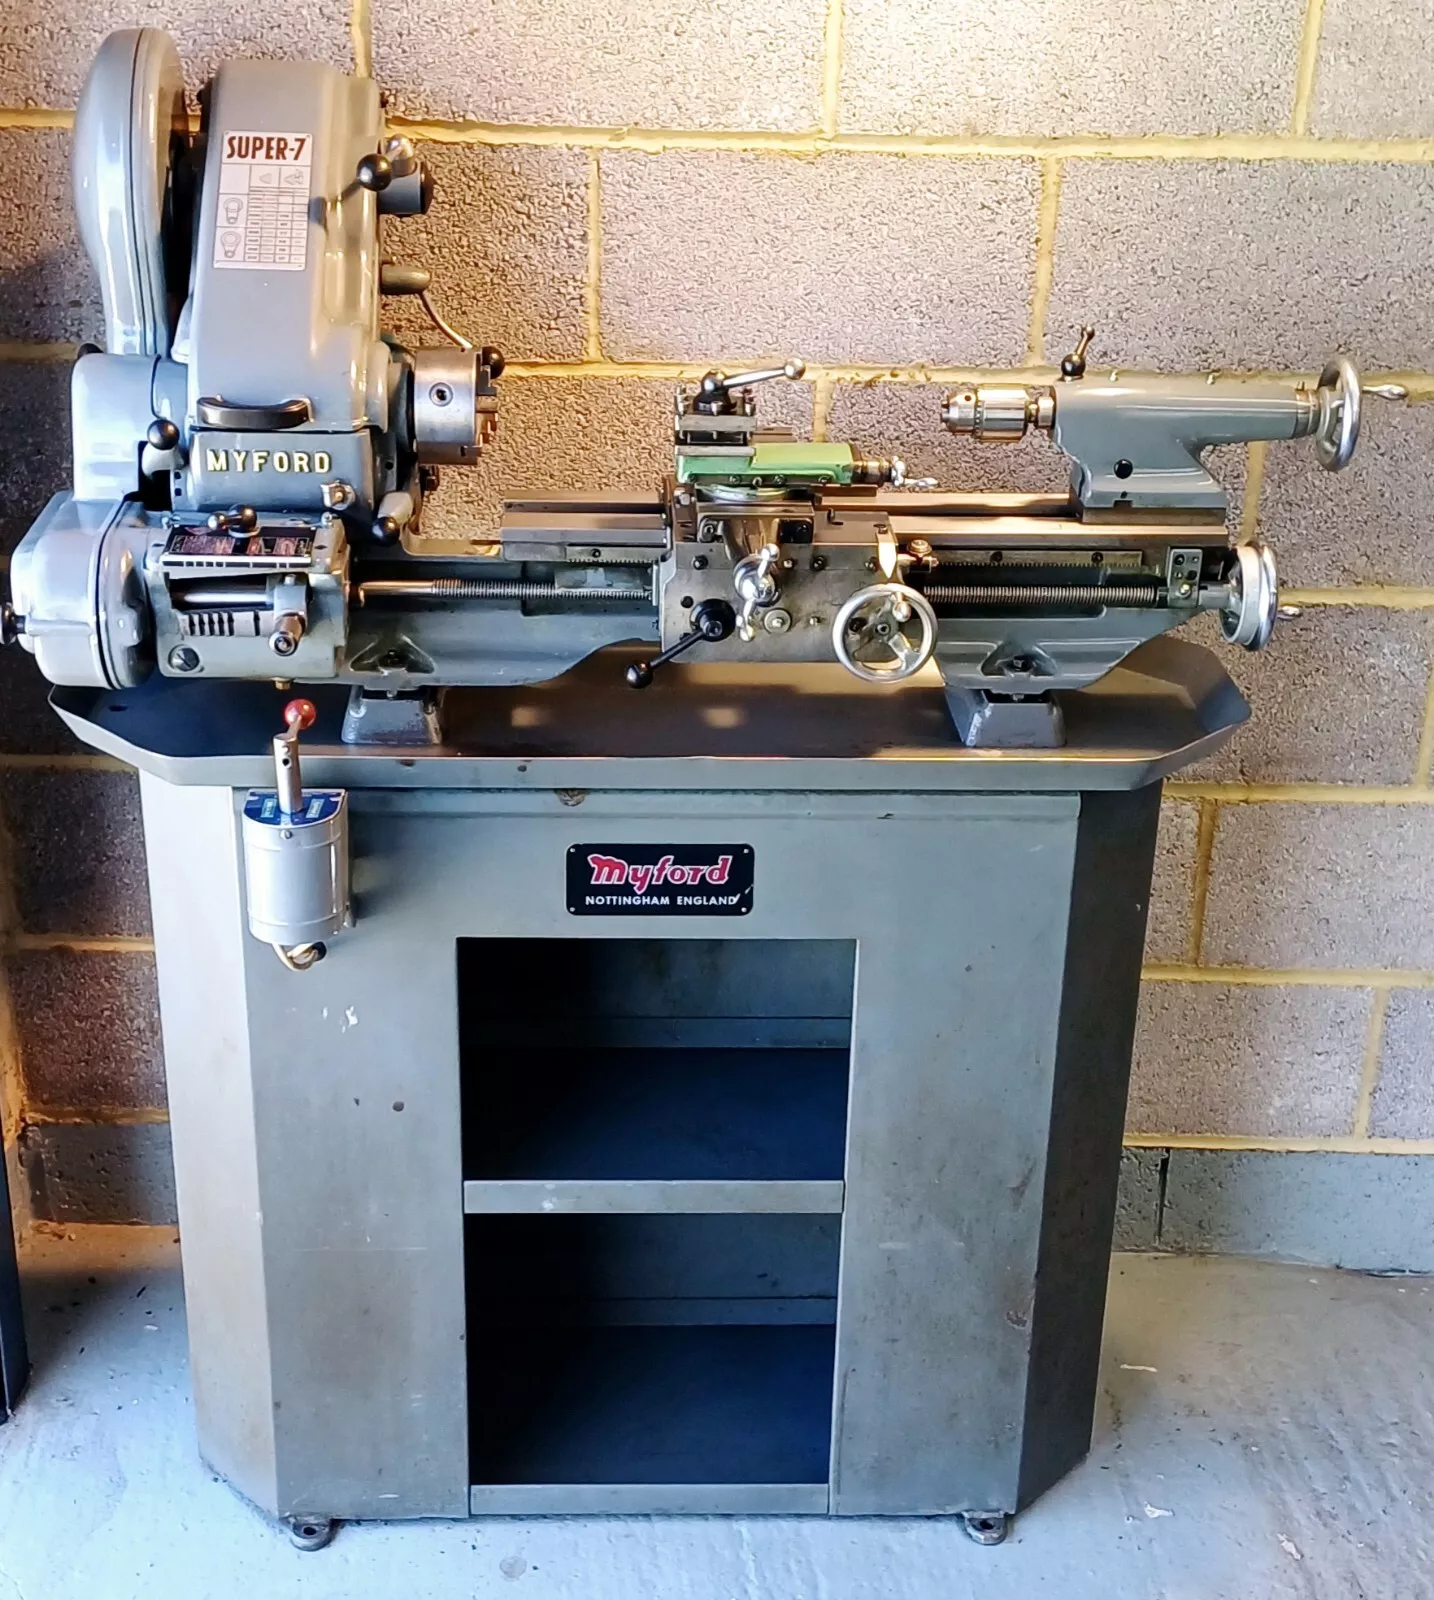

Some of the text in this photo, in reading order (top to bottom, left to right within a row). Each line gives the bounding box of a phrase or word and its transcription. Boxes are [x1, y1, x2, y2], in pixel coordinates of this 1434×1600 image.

[227, 135, 307, 161] SUPER-7
[206, 448, 332, 473] MYFORD
[587, 853, 734, 895] Myford
[585, 896, 737, 906] NOTTINGHAM ENGLAND
